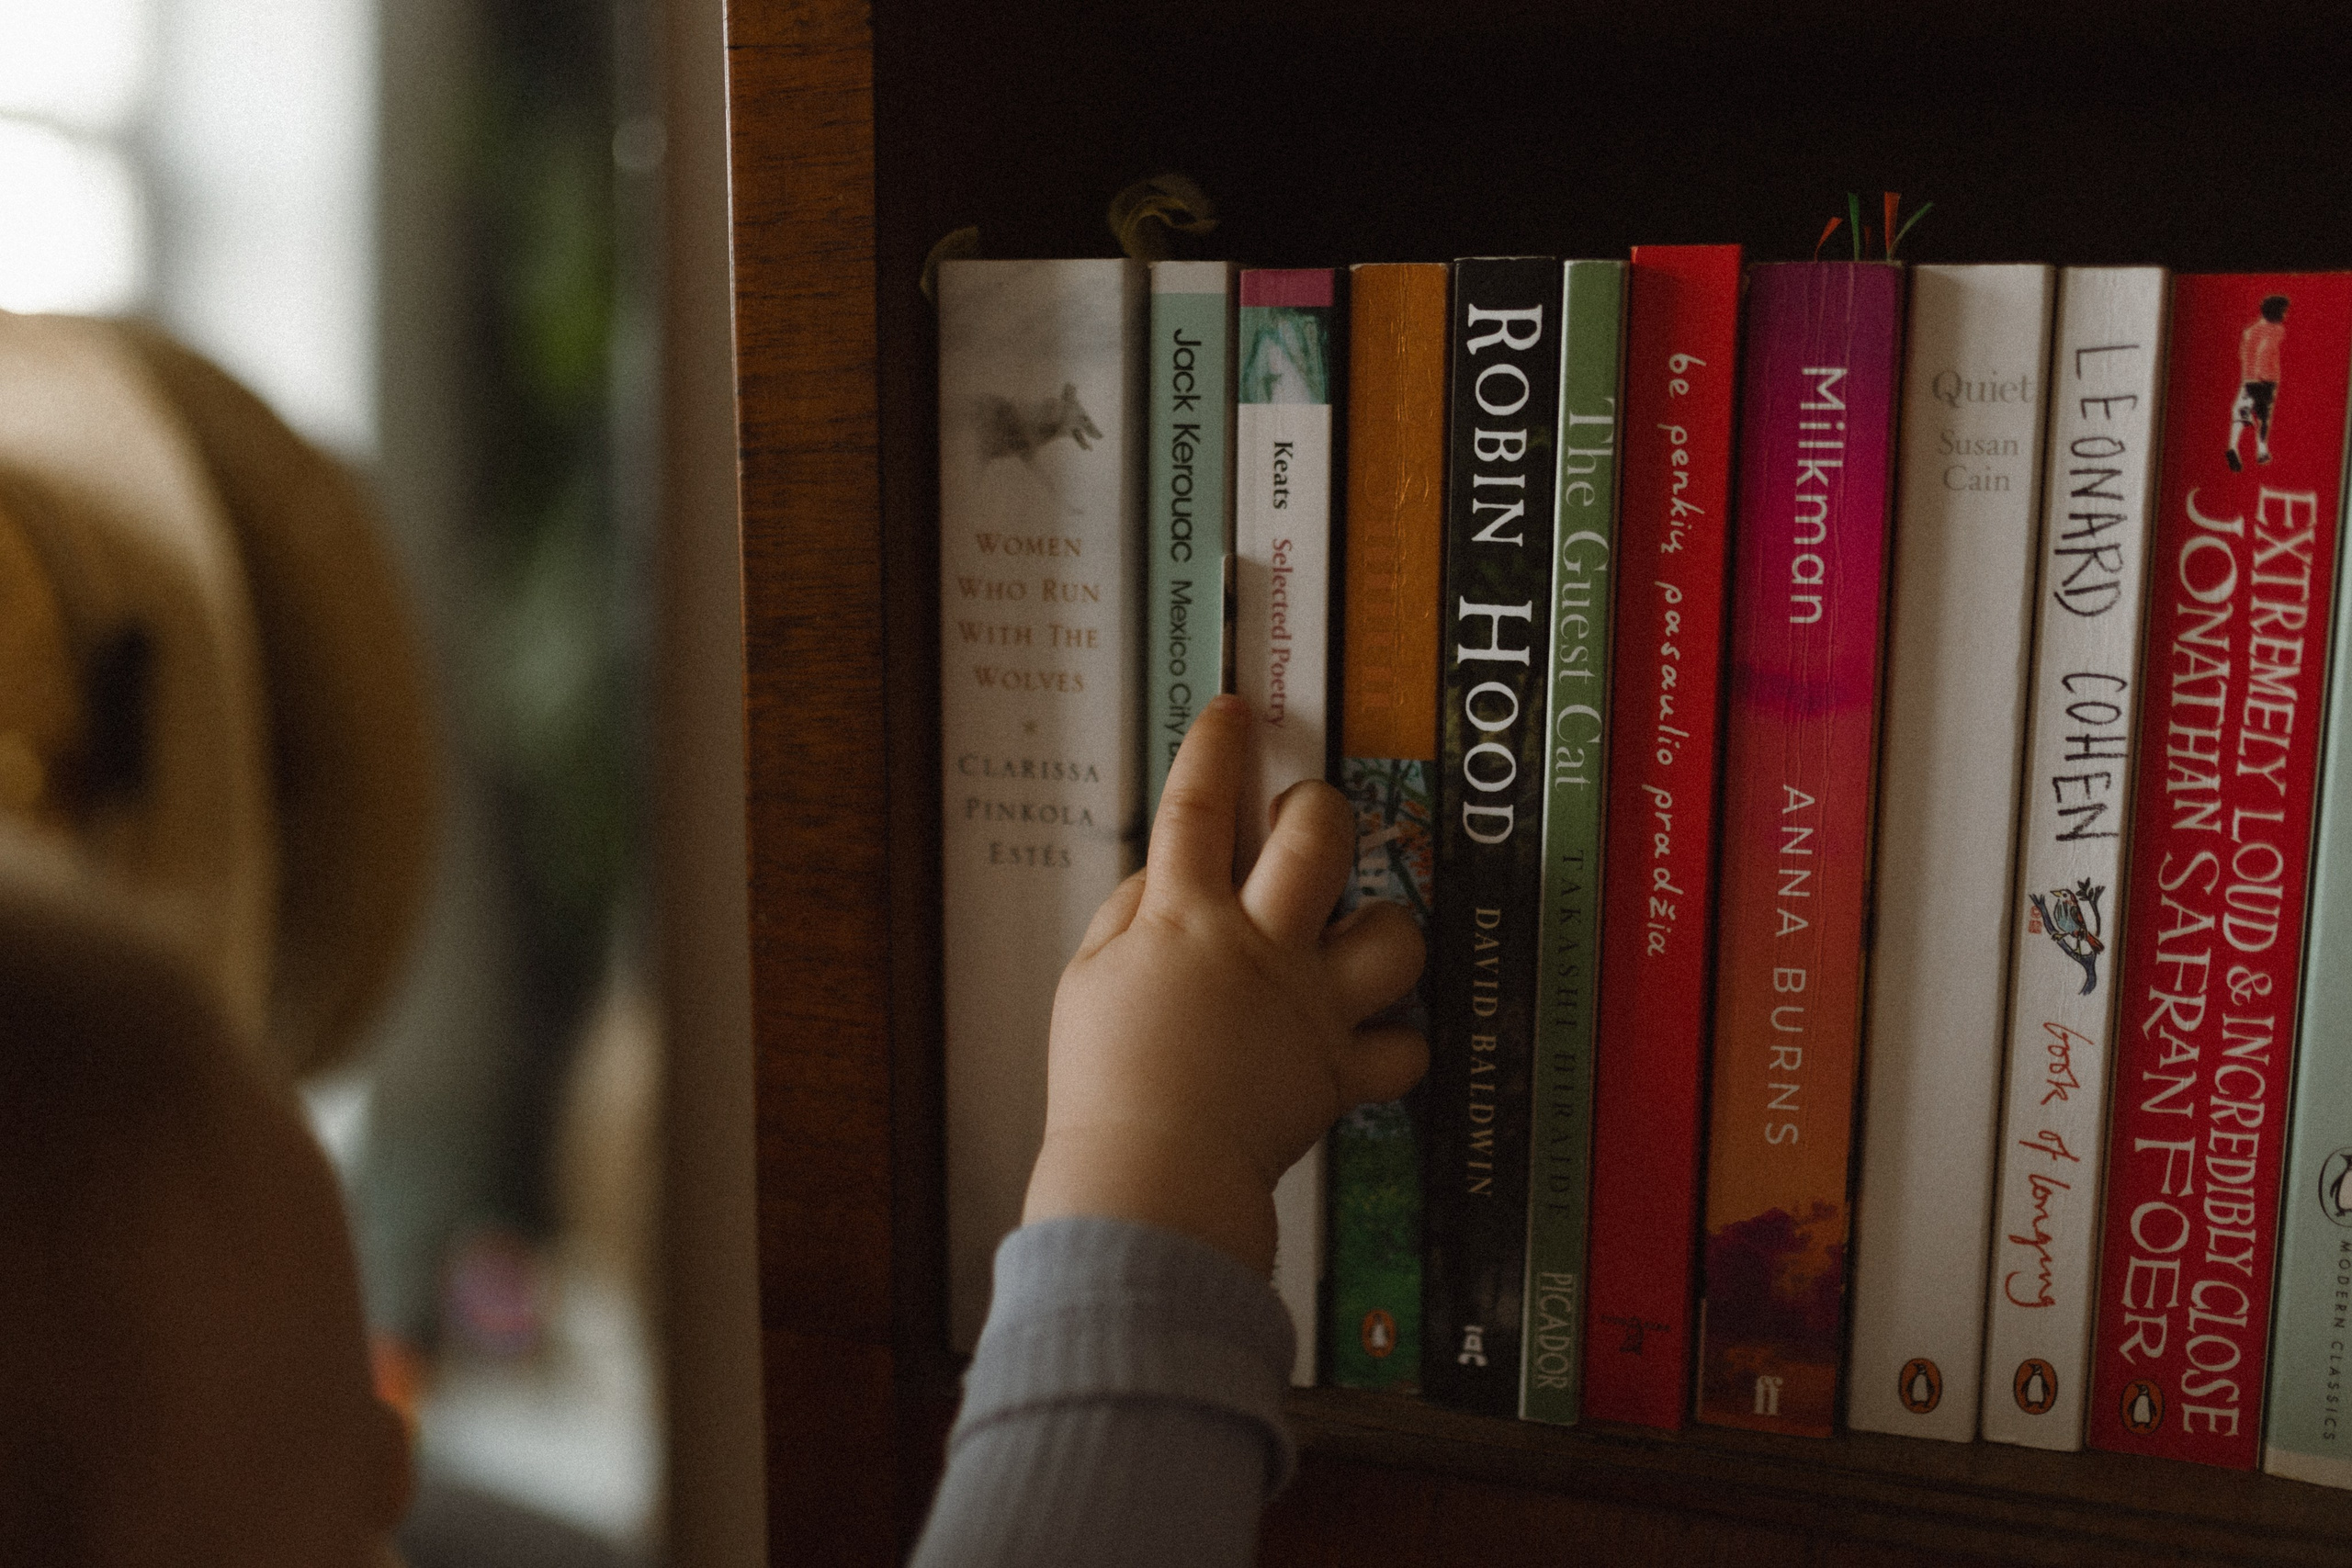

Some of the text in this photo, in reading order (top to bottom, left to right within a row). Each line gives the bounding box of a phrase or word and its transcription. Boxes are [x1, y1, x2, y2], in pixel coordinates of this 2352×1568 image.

[1172, 328, 1202, 412] Jack
[1932, 369, 2037, 406] Quiet
[1170, 423, 1201, 562] Kerouac
[1789, 367, 1848, 624] Milkman
[1938, 429, 2019, 456] Susan
[1943, 466, 2010, 491] Cain
[959, 577, 1099, 603] WHO RUN
[975, 533, 1081, 557] WOMEN
[1263, 441, 1293, 728] Keats Selected Poetry
[1455, 303, 1544, 845] ROBIN HOOD
[1555, 397, 1615, 790] The Guest Cat
[2052, 344, 2140, 842] LEONARD COHEN
[959, 623, 1096, 649] WITH THE
[974, 667, 1084, 693] WOLVES
[1169, 580, 1193, 676] Mexico
[1642, 352, 1707, 955] be penkių pasaulio pradžia
[957, 755, 1099, 783] CLARISSA
[1165, 683, 1191, 734] City
[967, 798, 1093, 827] PINKOLA
[1765, 784, 1815, 1146] ANNA BURNS
[2120, 487, 2245, 1365] JONATHAN SAFRAN FOER
[2181, 487, 2318, 1437] EXTREMELY LOUD & INCREDIBLY CLOSE
[1467, 908, 1501, 1198] DAVID BALDWIN
[1548, 852, 1584, 1214] TAKASHI HIRAIDE
[2005, 1021, 2094, 1309] book of longing
[1536, 1271, 1575, 1392] PICADOR
[1754, 1375, 1784, 1416] ff
[2322, 1240, 2352, 1442] MODERN CLASSICS
